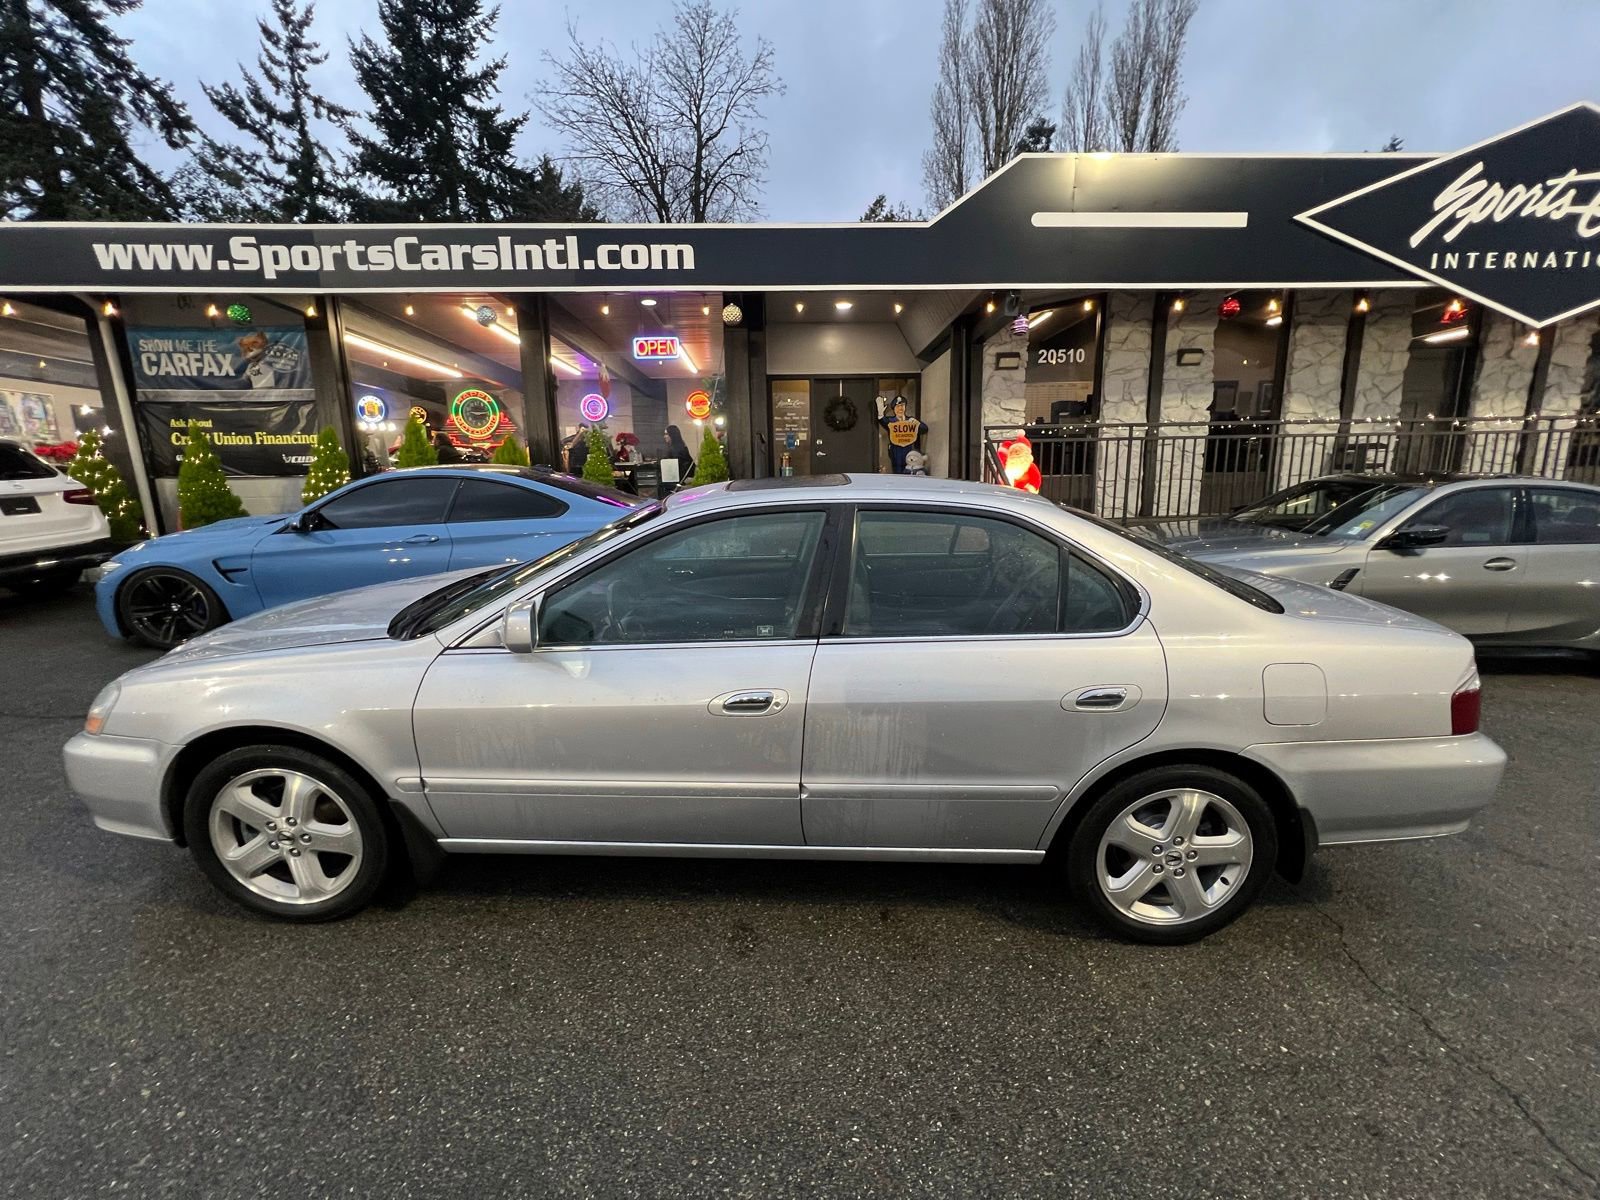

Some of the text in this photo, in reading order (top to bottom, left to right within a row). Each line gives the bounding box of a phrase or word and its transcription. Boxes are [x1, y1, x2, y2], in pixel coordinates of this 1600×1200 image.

[1409, 161, 1577, 249] Sports
[92, 236, 695, 279] www.SportsCarsIntl.com
[1430, 251, 1600, 270] INTERNATI
[139, 339, 218, 353] SHOW ME THE
[635, 340, 678, 356] OPEN
[1037, 348, 1086, 364] 20510
[141, 352, 236, 377] CARFAX
[456, 391, 493, 405] HAPPY
[170, 419, 213, 428] Ask Aout
[893, 424, 917, 433] SLOW
[170, 431, 318, 446] Crt Union Financing
